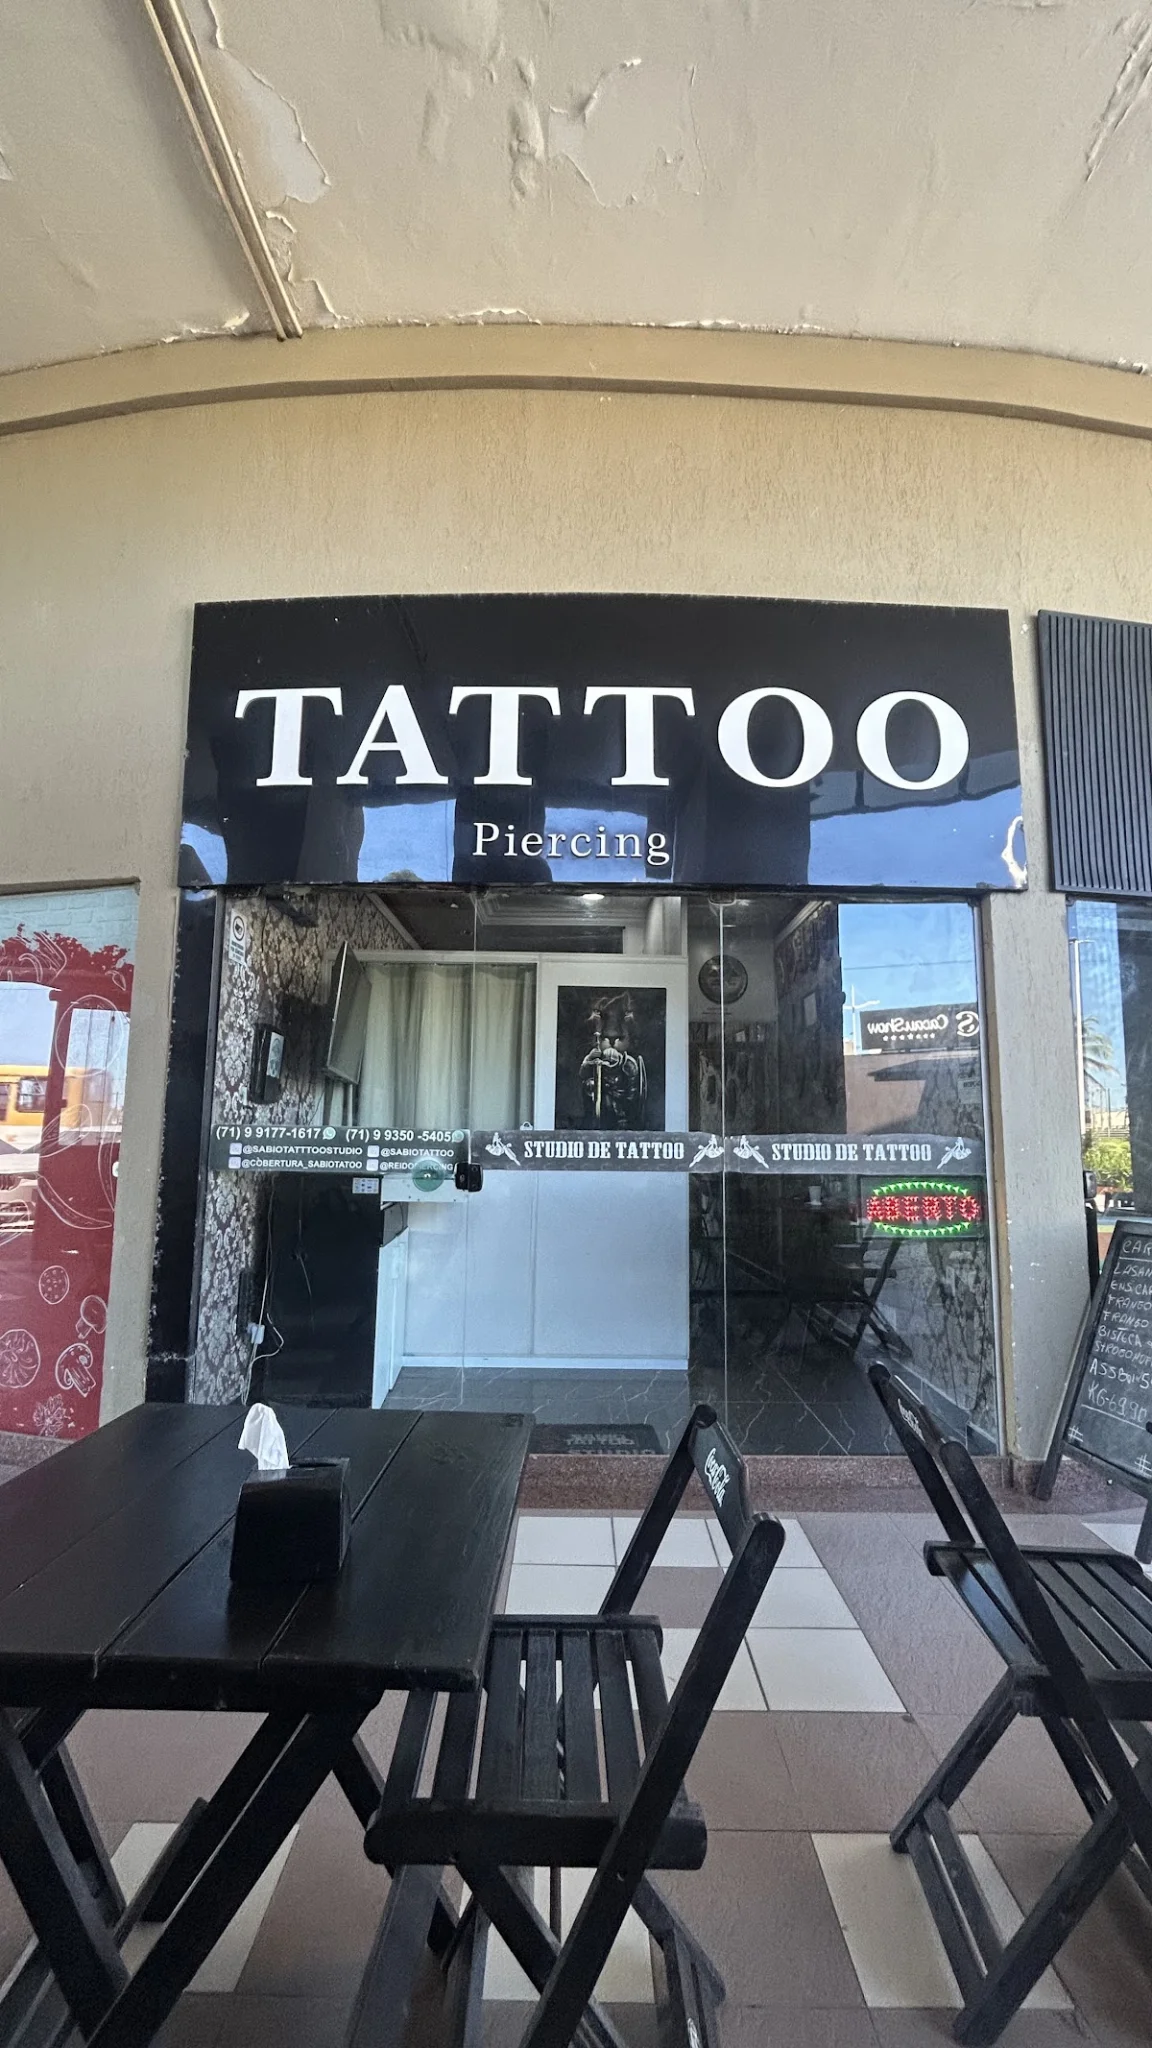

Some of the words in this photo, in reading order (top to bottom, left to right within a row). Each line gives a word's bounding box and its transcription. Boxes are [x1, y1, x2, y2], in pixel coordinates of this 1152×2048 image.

[234, 684, 970, 791] TATTOO
[473, 821, 671, 866] Piercing
[216, 1126, 241, 1140] (71)
[244, 1127, 252, 1138] 9
[255, 1127, 321, 1139] 9177-1617
[345, 1128, 370, 1143] (71)
[373, 1129, 381, 1141] 9
[384, 1129, 414, 1141] 9350
[242, 1145, 363, 1155] @SABIOTATTTOOSTUDIO
[380, 1147, 455, 1158] @SABIOTATTOO
[523, 1140, 583, 1160] STUDIO
[588, 1141, 611, 1160] DE
[615, 1142, 685, 1161] TATTOO
[771, 1142, 832, 1162] STUDIO
[835, 1143, 858, 1162] DE
[863, 1143, 932, 1162] TATTOO
[866, 1195, 980, 1222] ABERTO
[1095, 1340, 1152, 1365] STROGONOF
